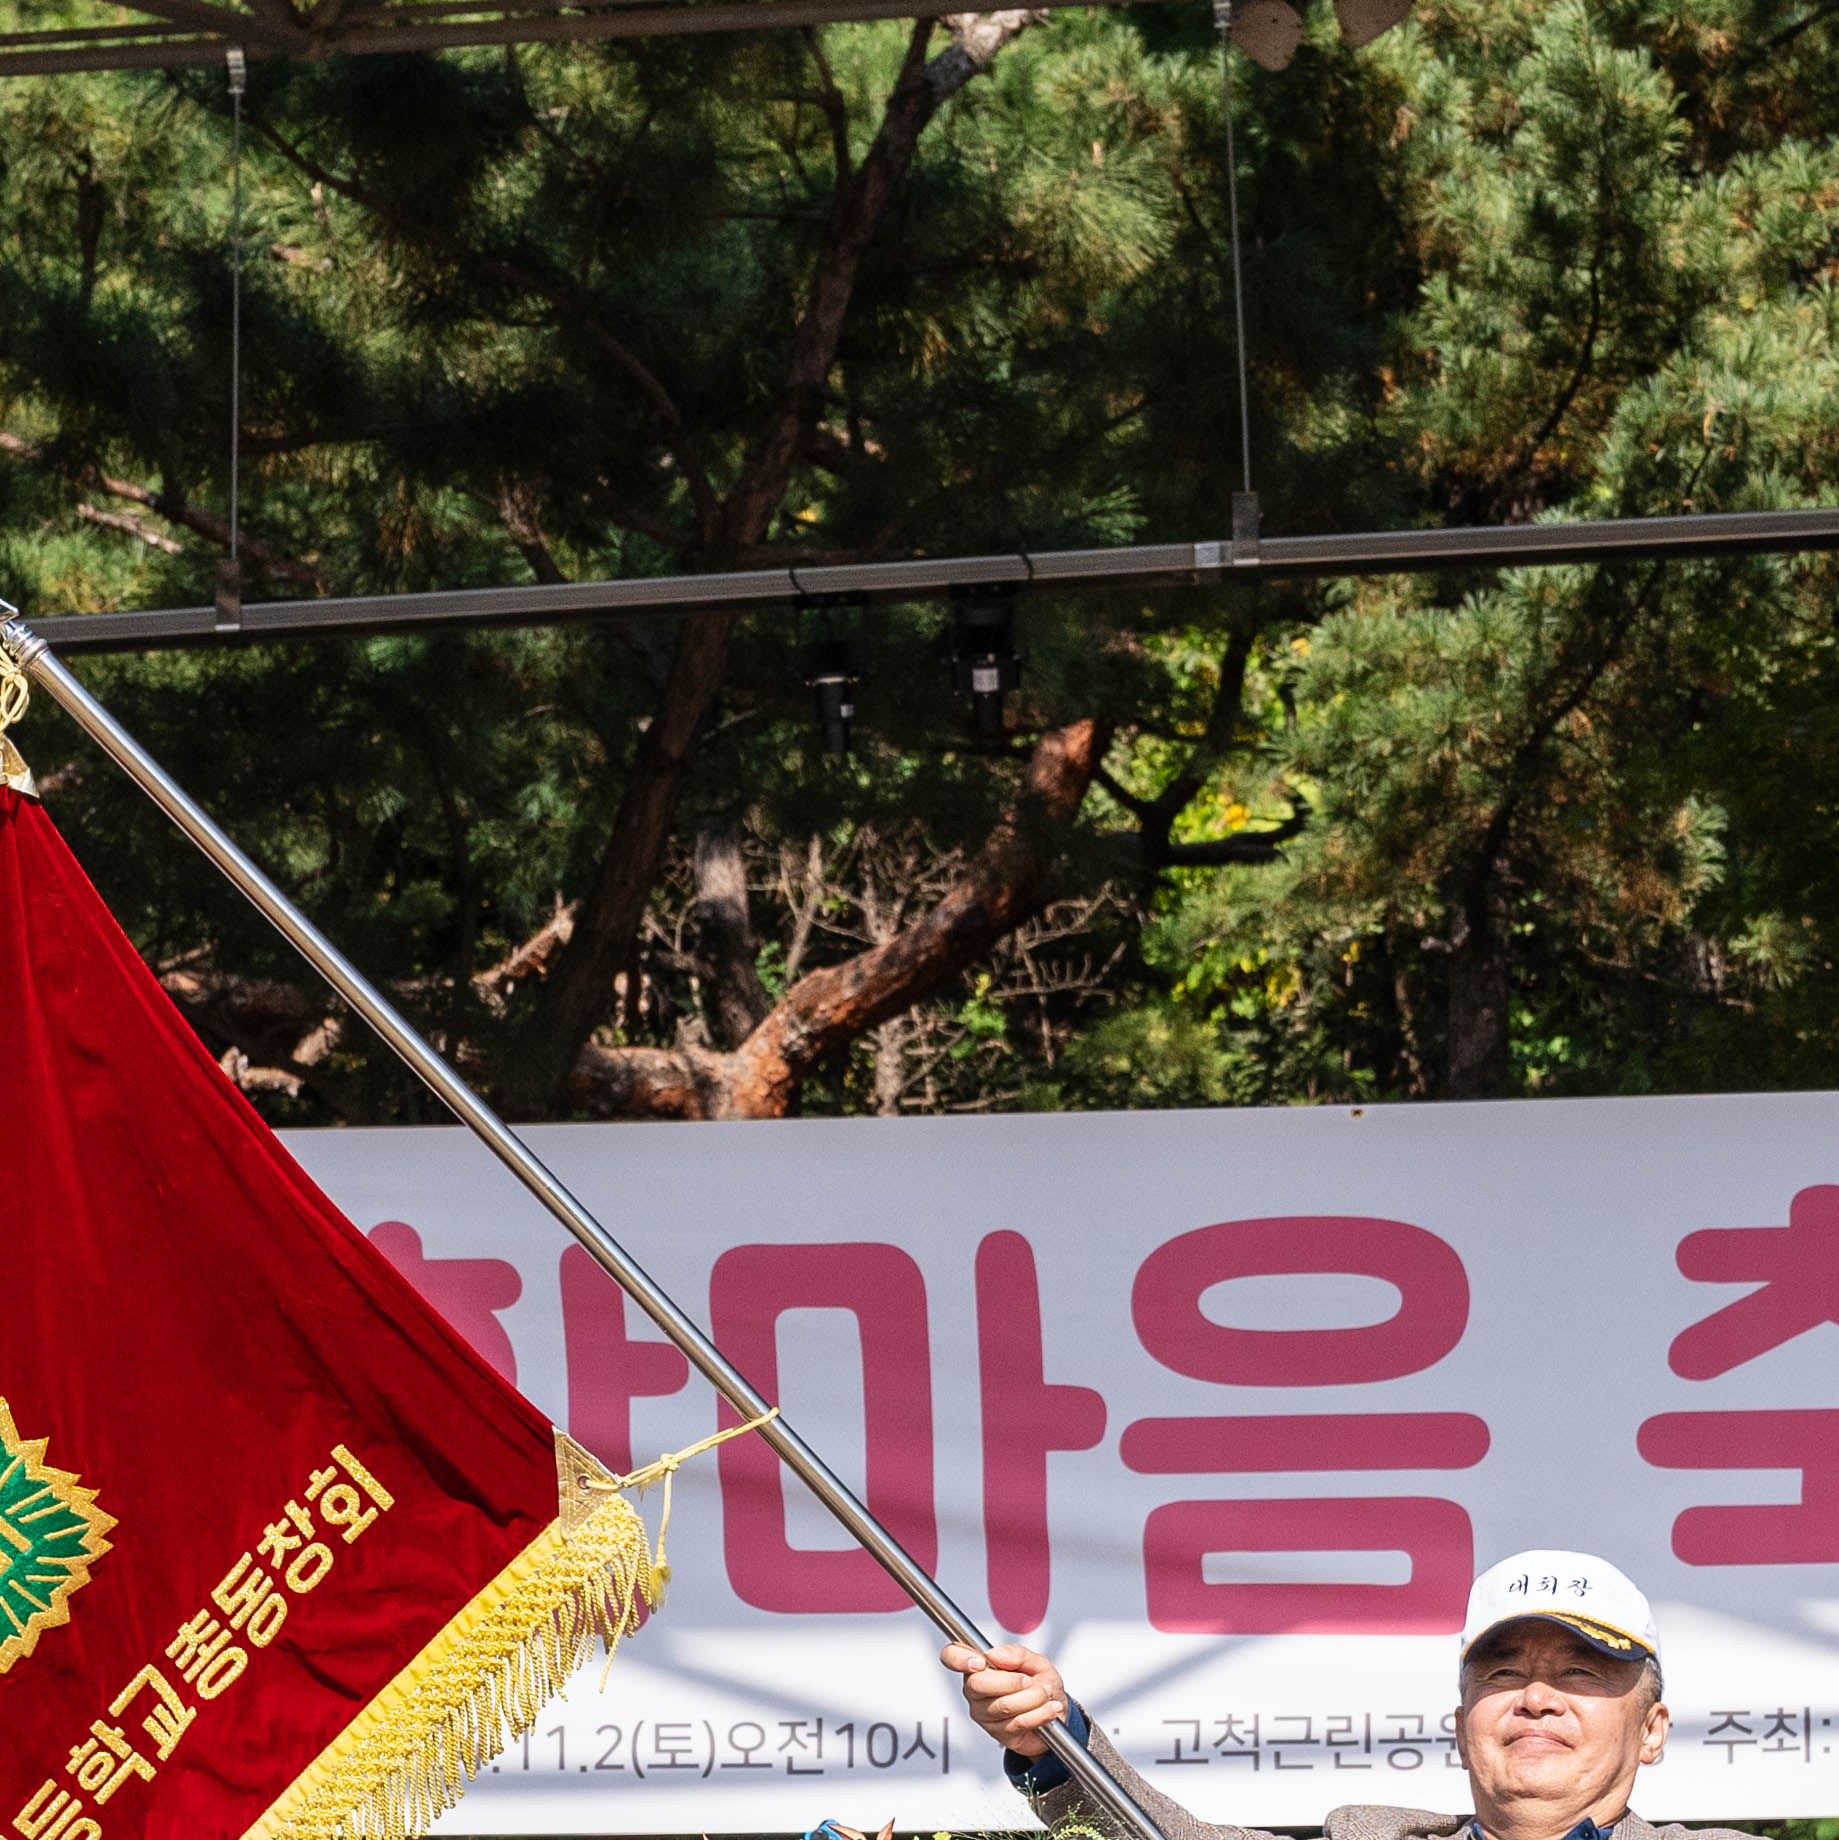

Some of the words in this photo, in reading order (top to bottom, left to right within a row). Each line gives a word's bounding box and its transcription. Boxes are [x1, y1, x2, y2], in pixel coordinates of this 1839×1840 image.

[1508, 1573, 1593, 1598] 대회장
[476, 1716, 951, 1778] .11.2(토)오전10시
[1701, 1706, 1833, 1765] 주최:
